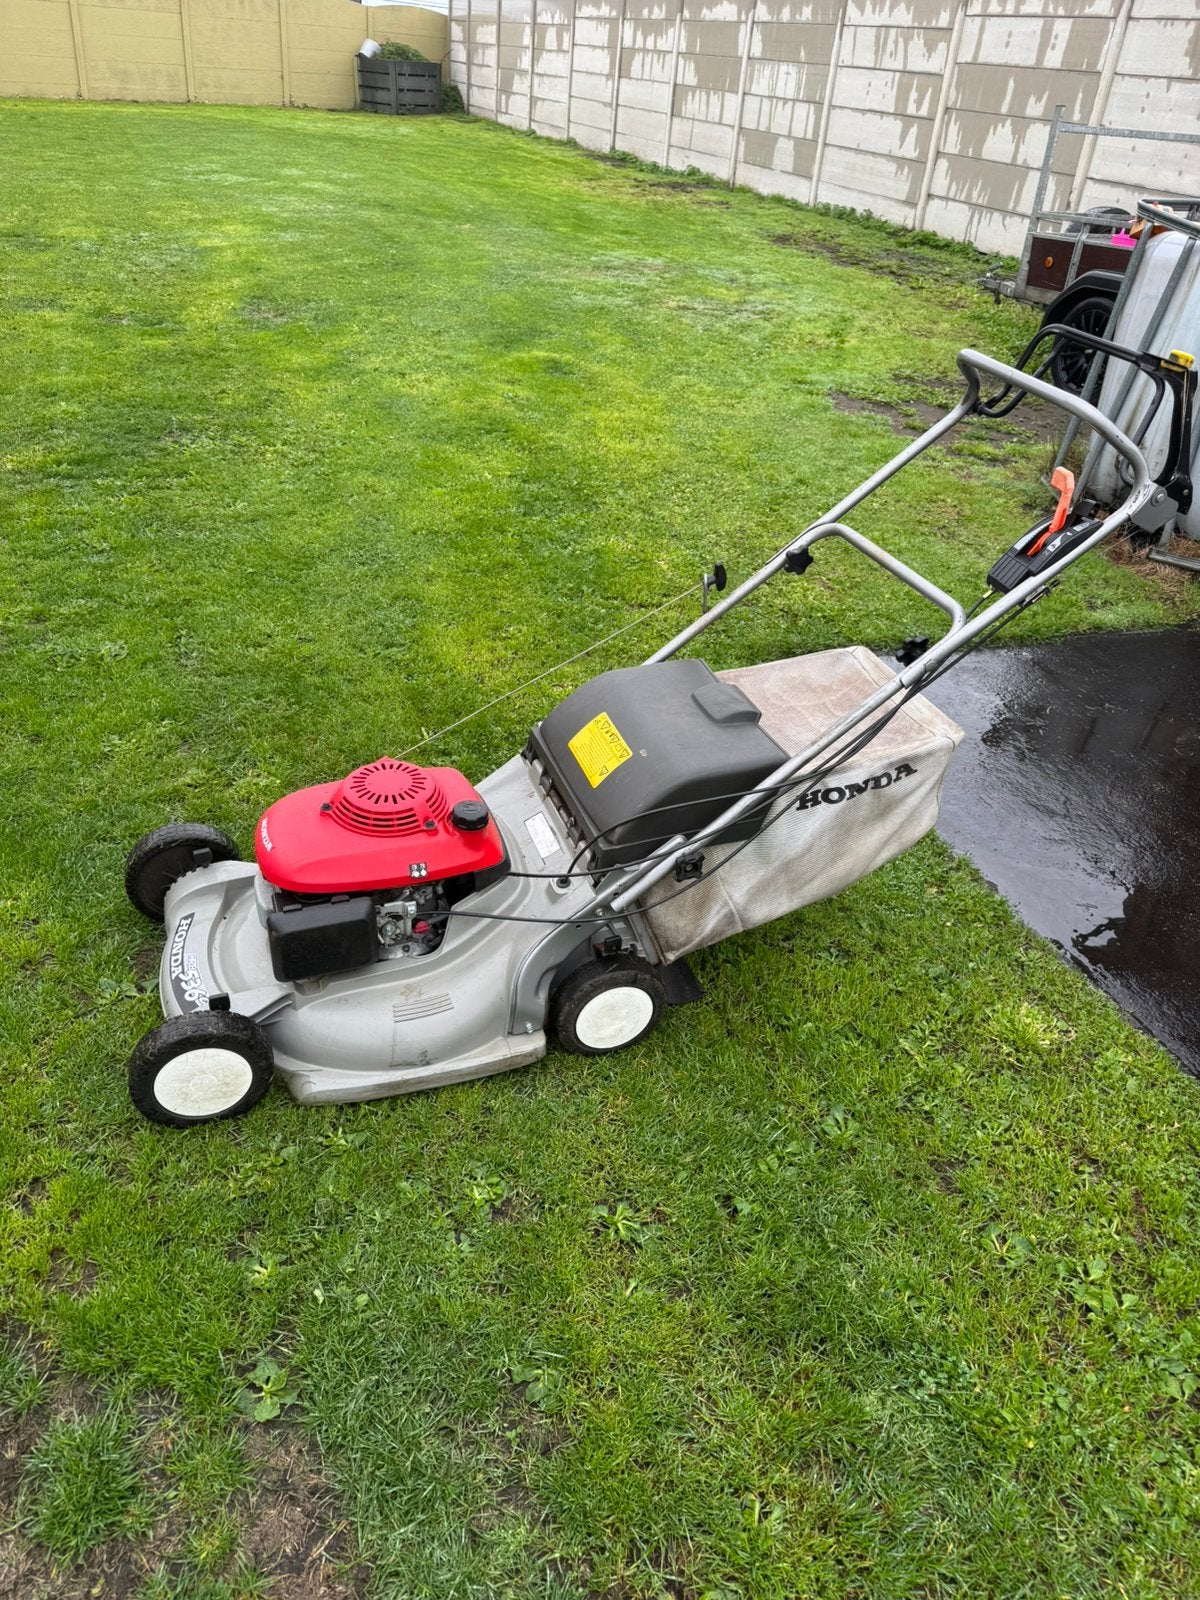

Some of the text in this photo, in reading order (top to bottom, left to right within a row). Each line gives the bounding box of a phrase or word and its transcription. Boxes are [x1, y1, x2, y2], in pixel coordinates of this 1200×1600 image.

[796, 763, 917, 811] HONDA
[261, 817, 272, 851] HONDA
[171, 917, 192, 980] HONDA
